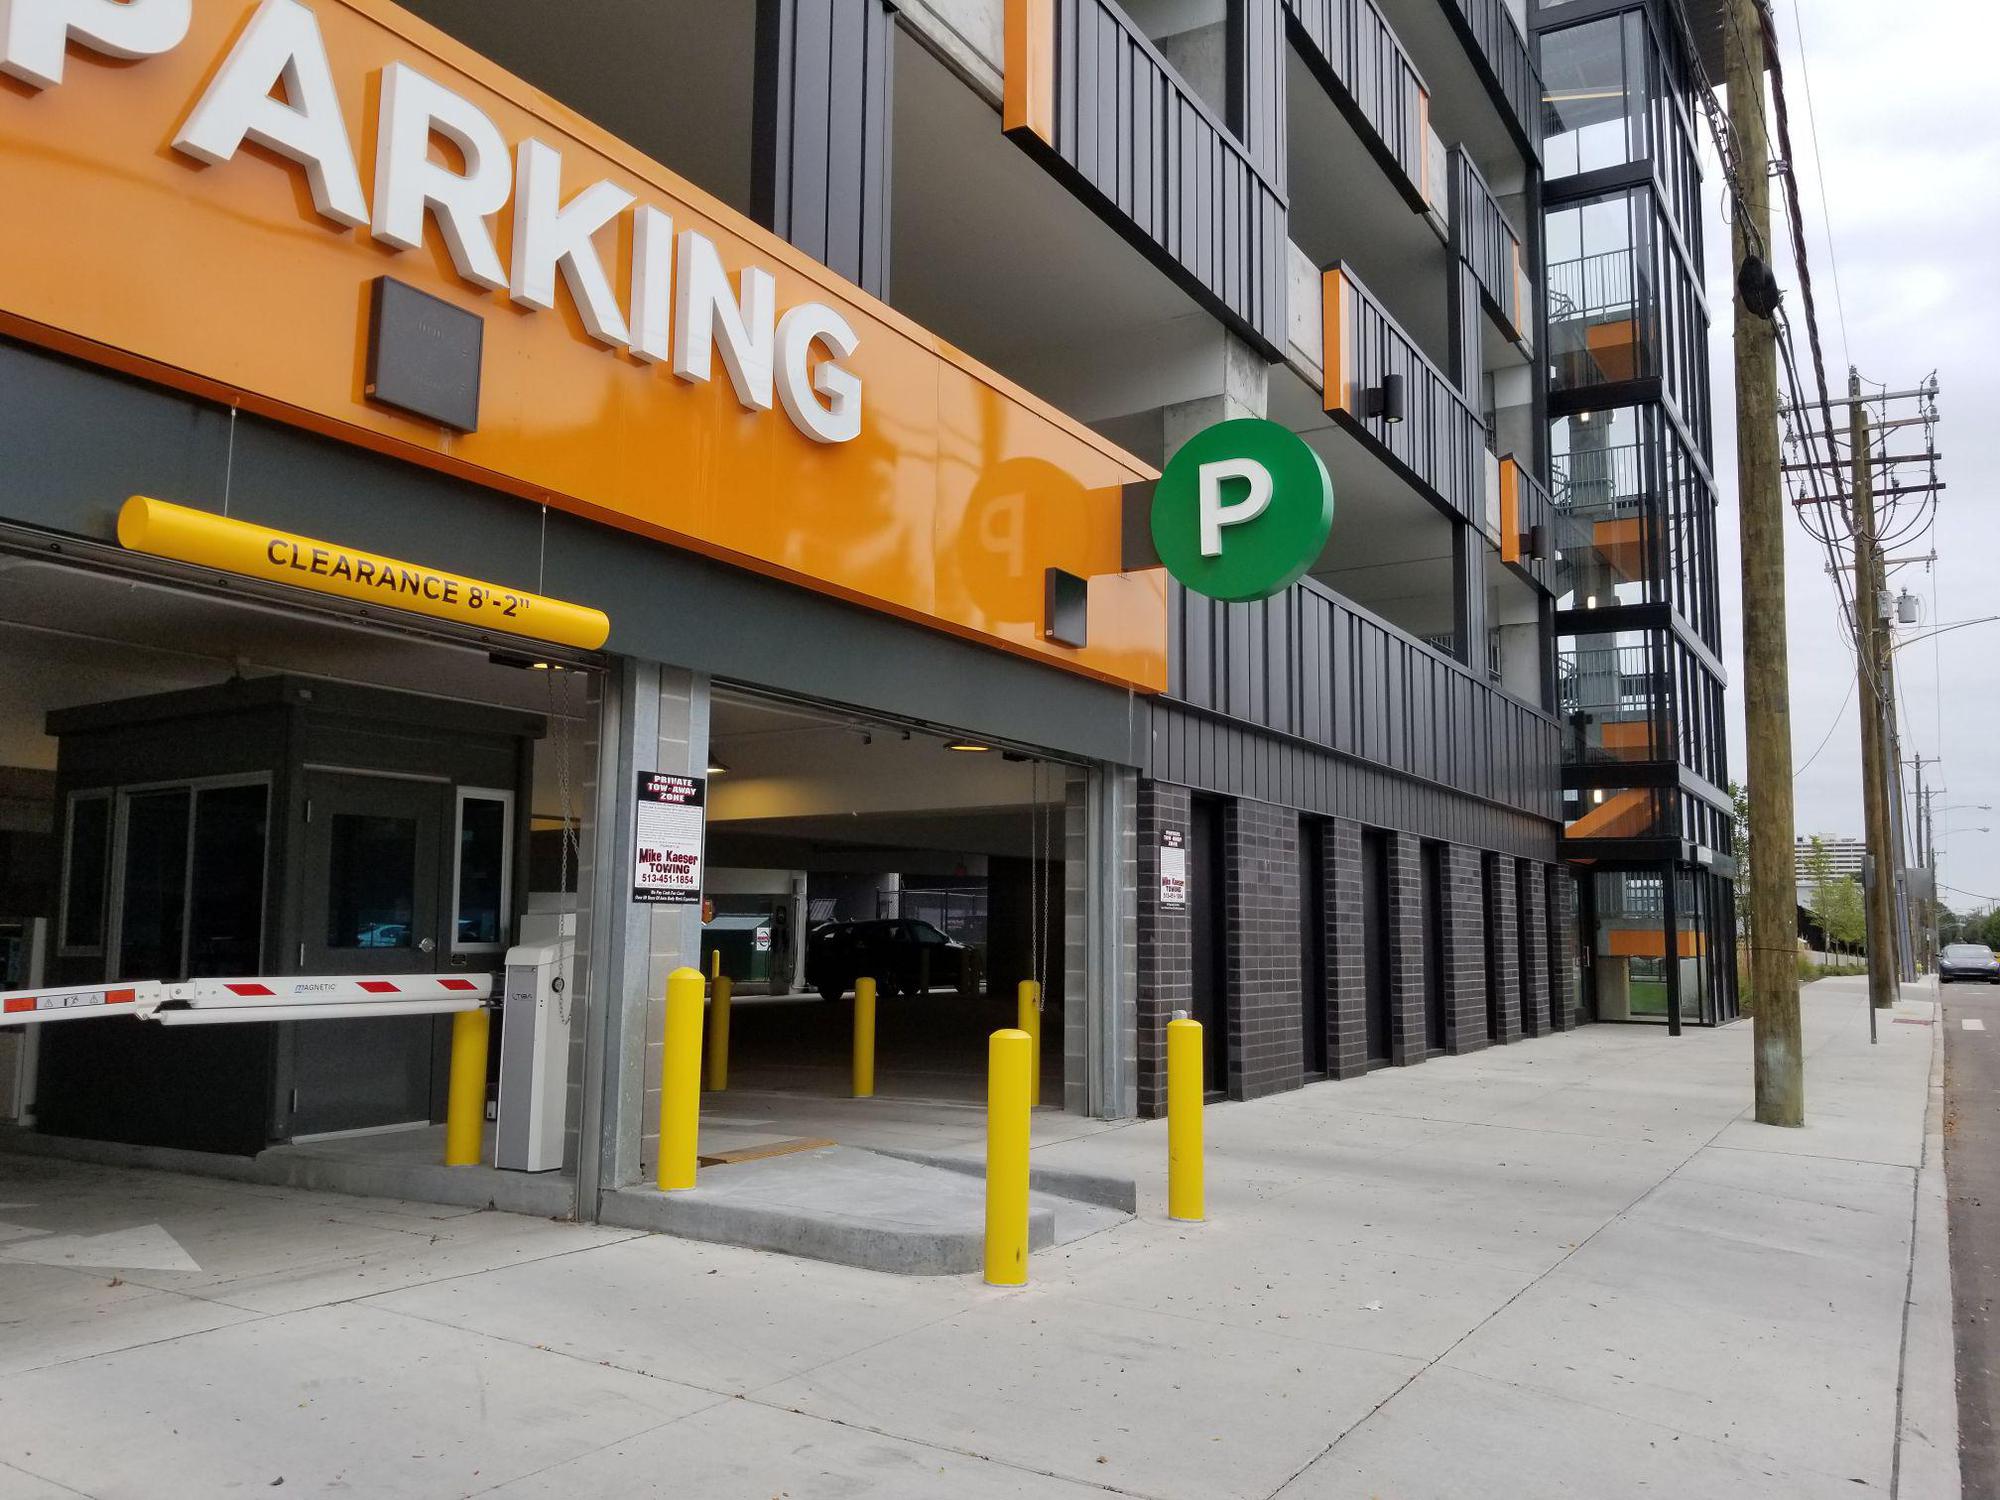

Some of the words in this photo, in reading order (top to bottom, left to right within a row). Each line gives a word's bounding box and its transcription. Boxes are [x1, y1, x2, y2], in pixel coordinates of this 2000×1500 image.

[1199, 457, 1274, 557] P
[267, 539, 459, 605] CLEARANCE
[654, 775, 693, 787] PRIVATE
[660, 792, 685, 802] ZONE
[639, 848, 662, 864] Mike
[665, 850, 698, 866] Kaeser
[649, 863, 690, 874] TOWING
[641, 873, 694, 884] 513-451-1854
